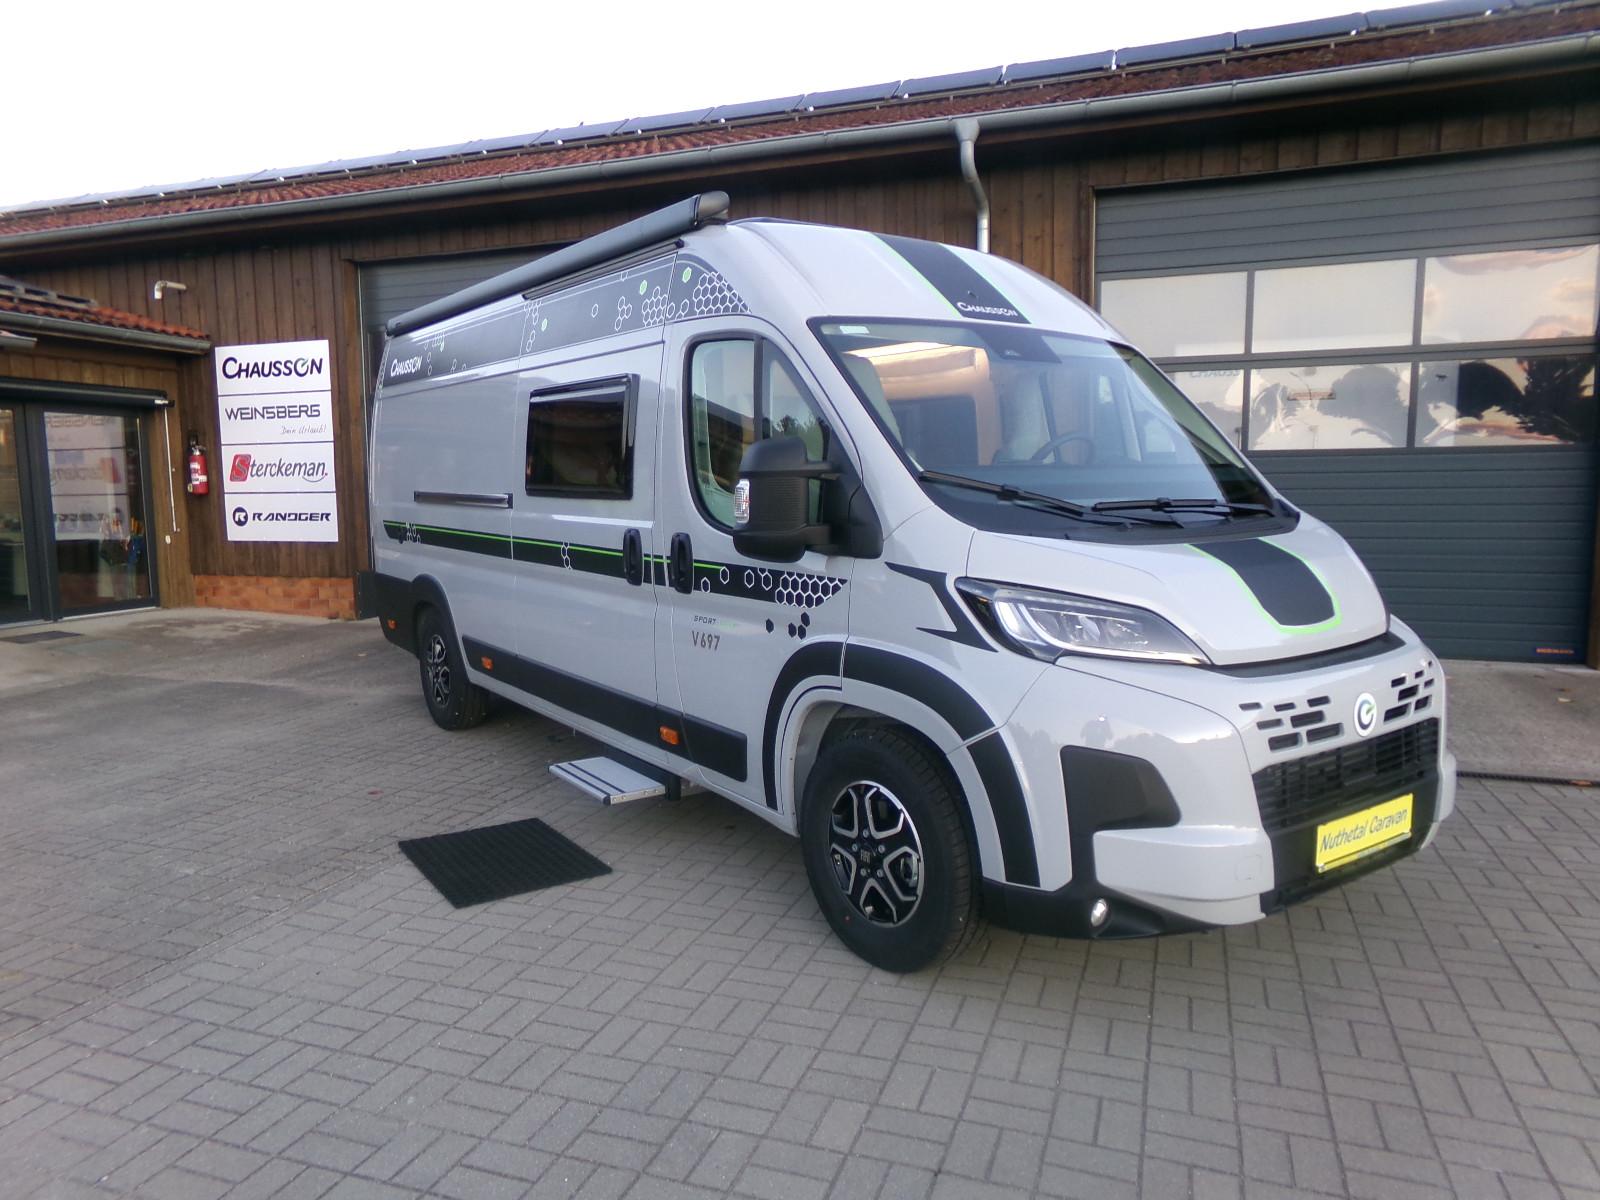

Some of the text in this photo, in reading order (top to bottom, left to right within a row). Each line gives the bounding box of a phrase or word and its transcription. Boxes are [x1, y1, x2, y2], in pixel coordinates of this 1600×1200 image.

[222, 356, 324, 380] CHAUSSON
[390, 355, 423, 377] CHAUSSON
[225, 404, 321, 421] WEINSBERG
[693, 615, 717, 624] SPORT
[691, 630, 721, 651] V697
[1320, 808, 1408, 852] Nuthetal Caravan
